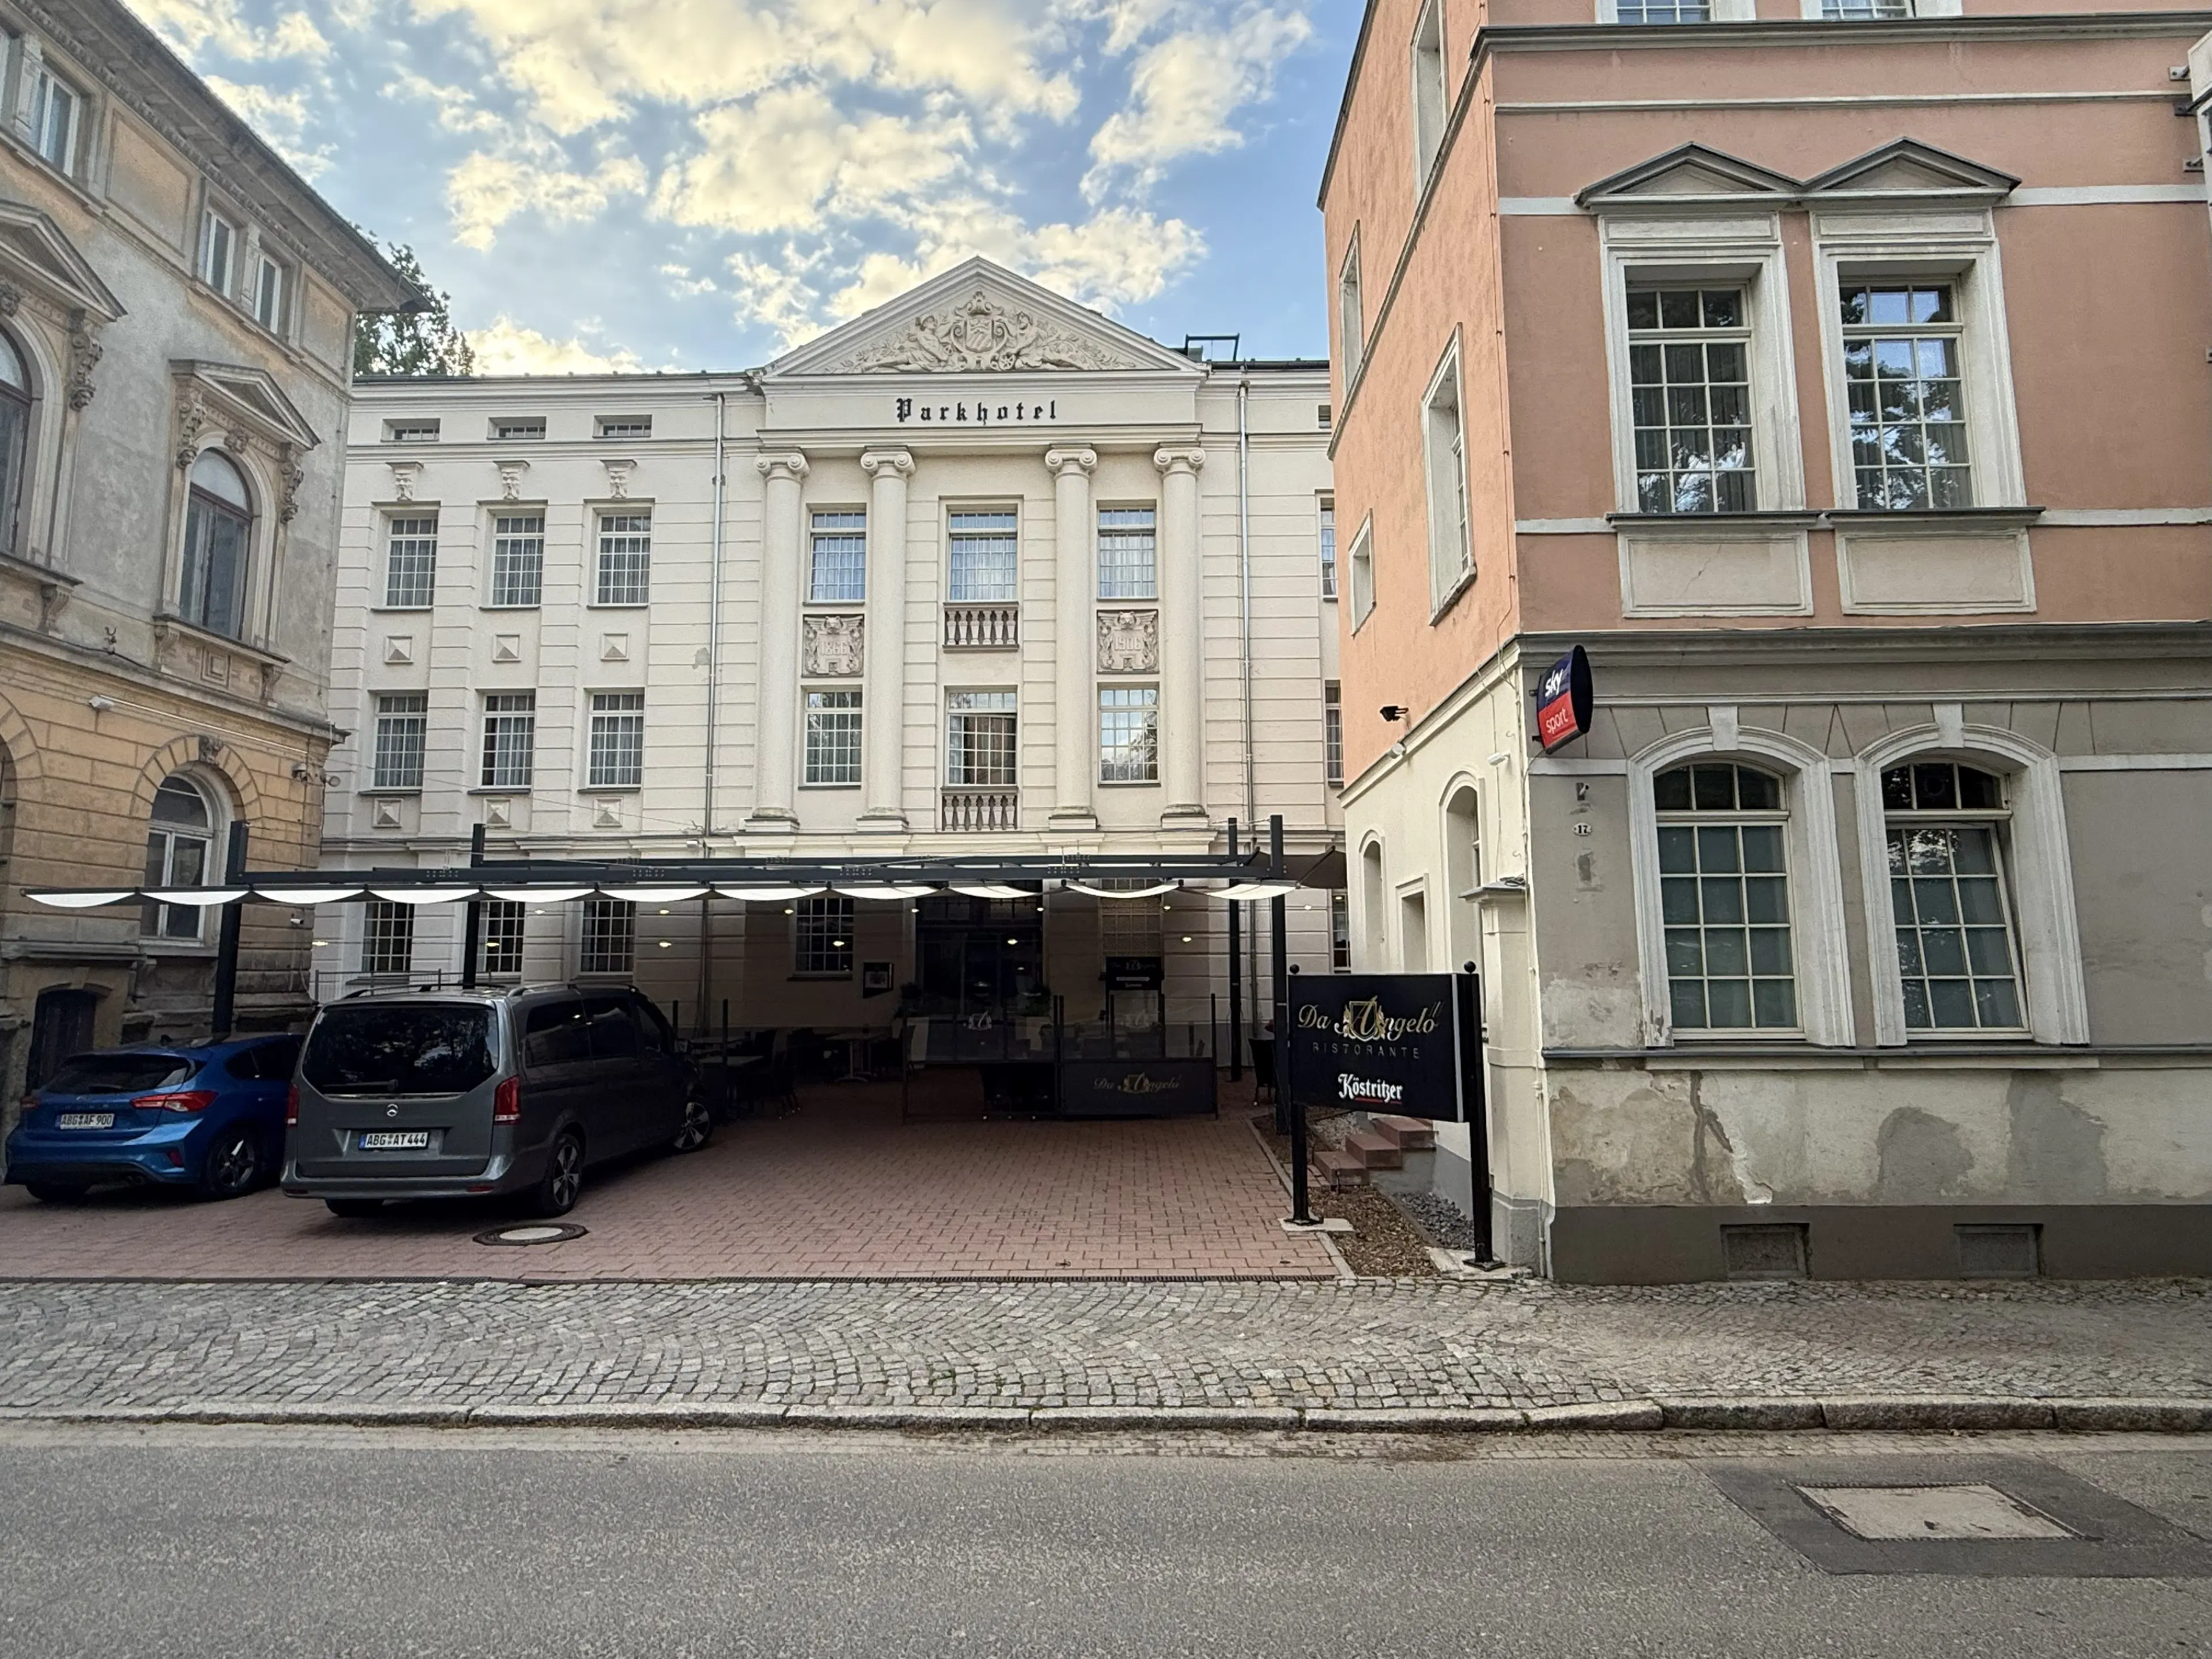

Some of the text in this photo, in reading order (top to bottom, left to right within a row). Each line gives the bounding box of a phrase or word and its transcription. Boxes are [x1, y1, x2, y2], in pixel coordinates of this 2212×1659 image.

[896, 397, 1056, 426] Parkhotel
[1115, 635, 1141, 650] 1906
[1544, 668, 1563, 697] sky
[1546, 708, 1569, 734] sport
[1578, 825, 1588, 834] 17
[1297, 1004, 1331, 1029] Da
[1312, 1041, 1420, 1060] RISTORANTE
[1093, 1077, 1114, 1089] Da
[1337, 1073, 1403, 1104] Köstritzer
[61, 1115, 78, 1126] ABG
[96, 1115, 112, 1126] 900
[367, 1134, 387, 1146] ABG
